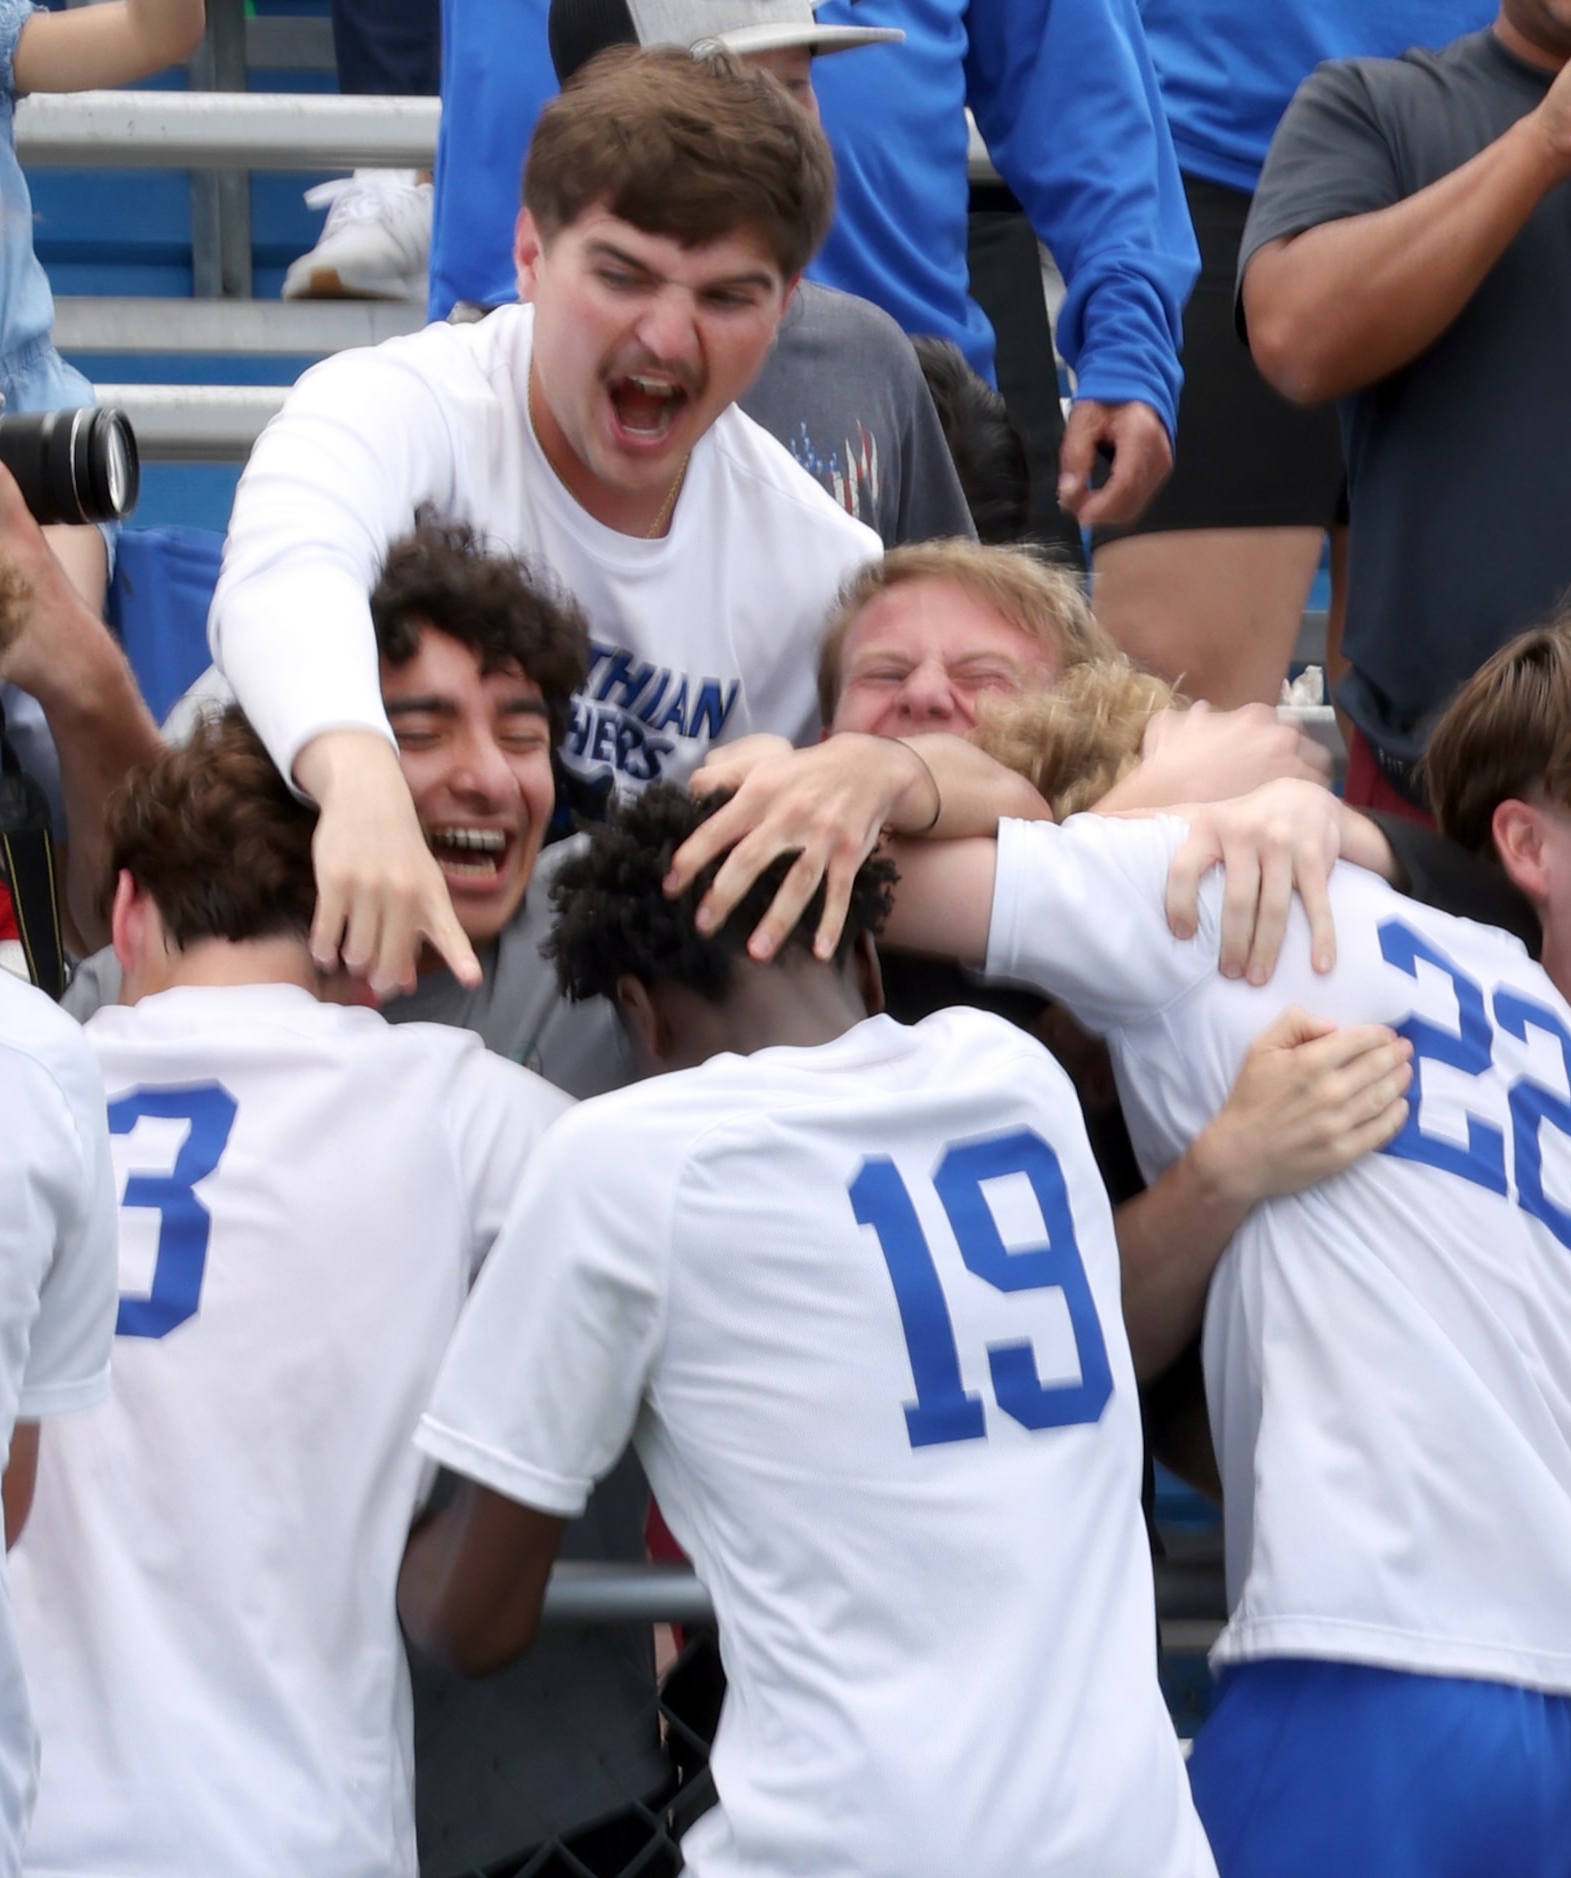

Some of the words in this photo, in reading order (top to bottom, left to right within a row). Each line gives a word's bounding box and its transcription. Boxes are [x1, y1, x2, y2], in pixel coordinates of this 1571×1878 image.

[569, 698, 677, 780] HERS
[587, 640, 740, 740] THIAN
[845, 1123, 1116, 1450] 19
